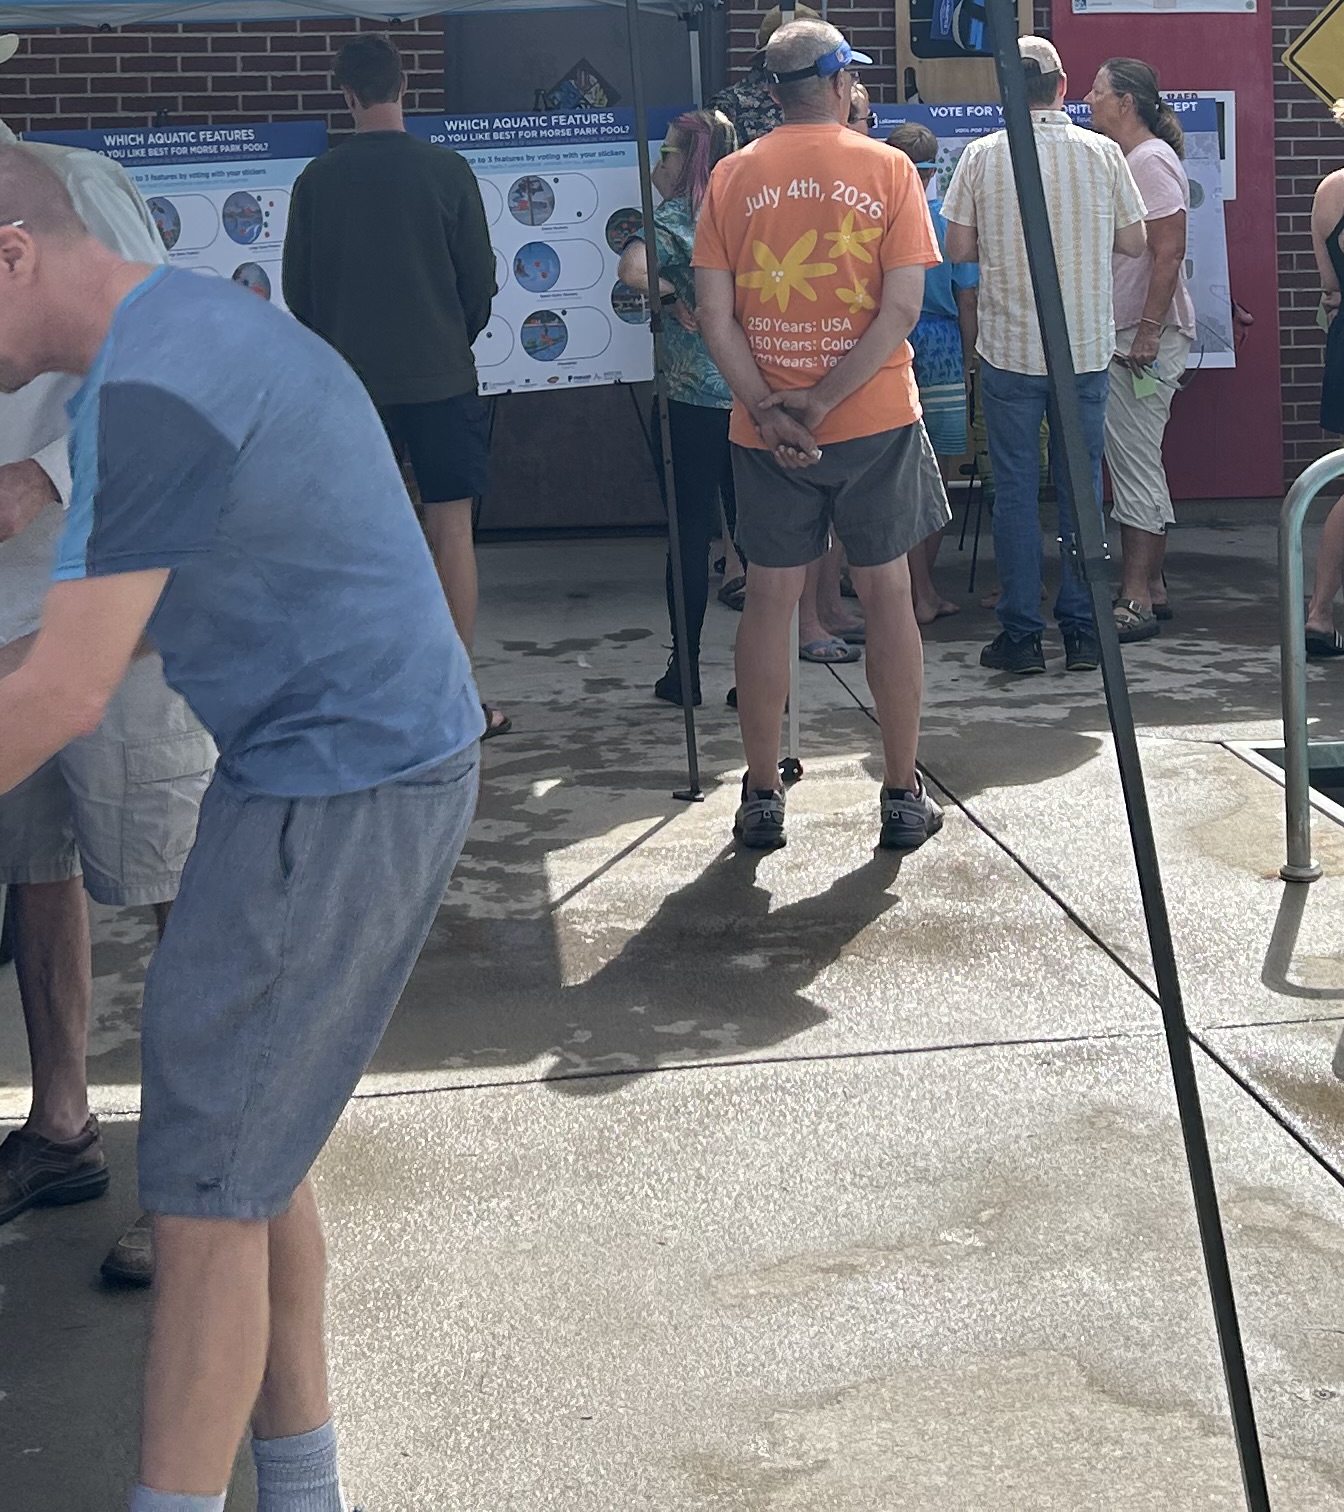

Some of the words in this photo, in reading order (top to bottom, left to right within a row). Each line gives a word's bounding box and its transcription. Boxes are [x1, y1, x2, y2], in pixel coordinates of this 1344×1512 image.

[930, 106, 963, 118] VOTE
[967, 106, 992, 117] FOR
[444, 118, 488, 131] WHICH
[492, 115, 547, 129] AQUATIC
[552, 113, 614, 126] FEATURES
[104, 133, 144, 146] WHICH
[148, 131, 196, 144] AQUATIC
[199, 129, 255, 142] FEATURES
[430, 135, 445, 144] DO
[448, 134, 468, 142] YOU
[470, 133, 490, 142] LIKE
[492, 131, 516, 140] BEST
[518, 130, 538, 139] FOR
[539, 128, 572, 138] MORSE
[574, 127, 598, 136] PARK
[600, 125, 630, 135] POOL?
[107, 149, 126, 158] YOU
[127, 148, 146, 158] LIKE
[148, 147, 168, 156] BEST
[170, 146, 188, 156] FOR
[190, 144, 218, 154] MORSE
[220, 143, 242, 153] PARK
[243, 142, 268, 152] POOL?
[494, 154, 525, 163] features
[526, 154, 535, 163] by
[537, 152, 560, 161] voting
[562, 151, 578, 159] with
[579, 151, 596, 160] your
[598, 149, 626, 158] stickers
[745, 184, 781, 217] July
[787, 177, 826, 202] 4th,
[831, 180, 884, 219] 2026
[748, 317, 771, 331] 250
[773, 318, 817, 333] Years:
[821, 317, 853, 332] USA
[749, 335, 771, 351] 150
[773, 337, 817, 351] Years:
[821, 336, 859, 351] Color
[775, 354, 817, 368] Years:
[820, 354, 843, 367] Ya
